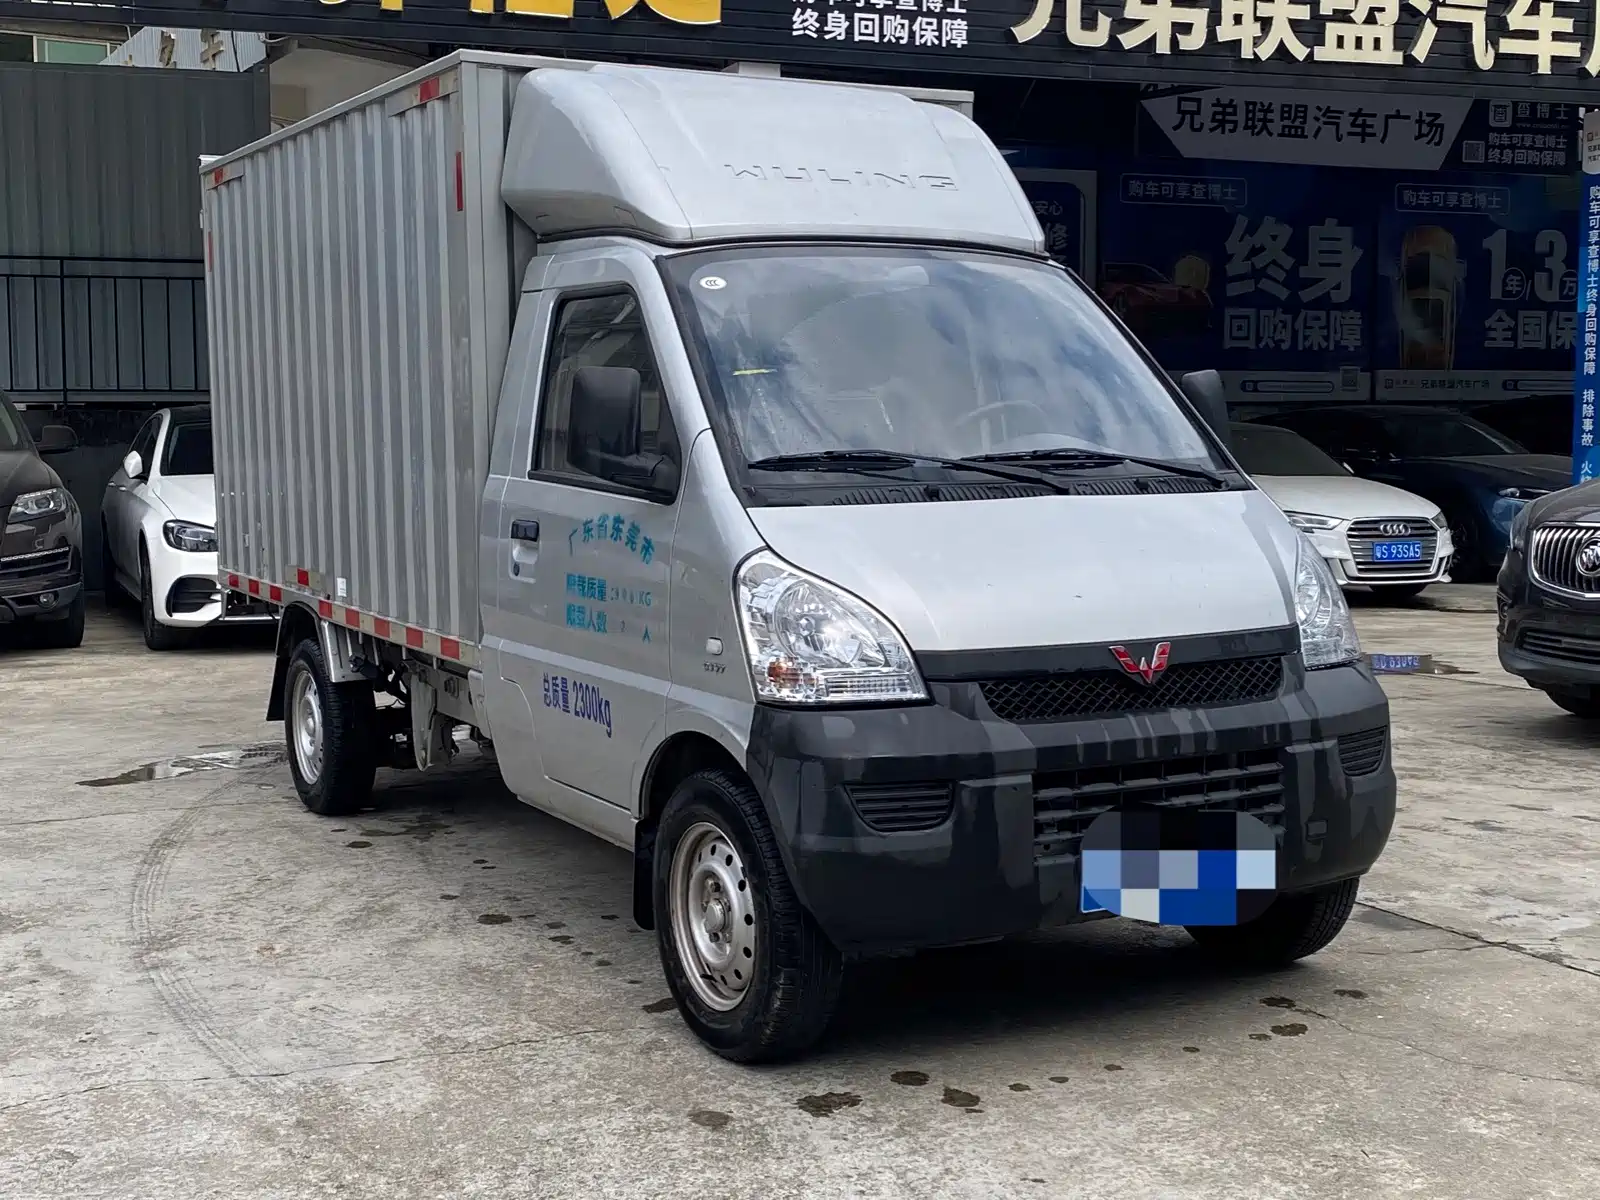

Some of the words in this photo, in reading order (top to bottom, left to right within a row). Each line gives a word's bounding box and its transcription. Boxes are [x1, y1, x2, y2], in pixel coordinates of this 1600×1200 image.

[792, 8, 969, 48] 终身回购保障
[1172, 95, 1445, 147] 兄弟联盟汽车广场
[1128, 179, 1238, 201] 购车可享查博士
[1402, 189, 1502, 209] 购车可享查博士
[1223, 213, 1364, 304] 终身
[1222, 306, 1364, 352] 回购保障
[1483, 308, 1576, 350] 全国保
[1580, 388, 1596, 447] 排除事故
[543, 672, 571, 714] 总质量
[572, 679, 613, 739] 2300kg
